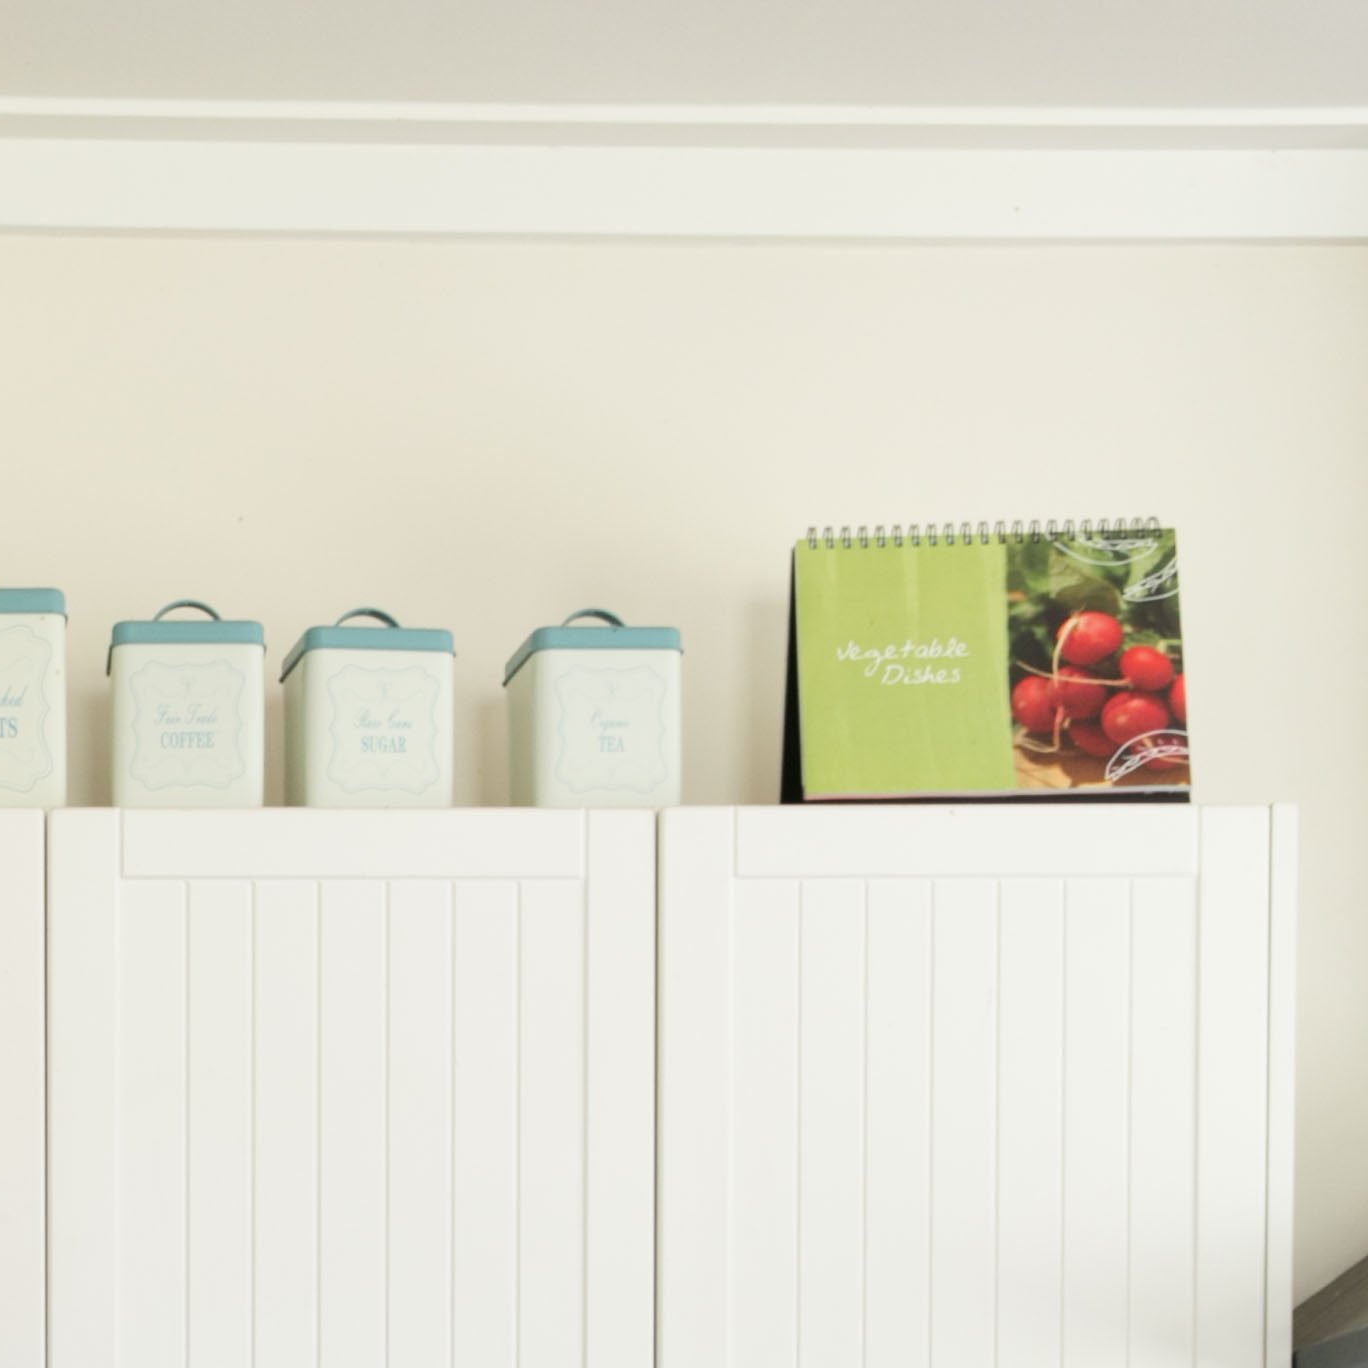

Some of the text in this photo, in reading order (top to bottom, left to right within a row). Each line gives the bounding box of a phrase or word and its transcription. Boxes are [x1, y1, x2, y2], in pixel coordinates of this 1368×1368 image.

[880, 662, 962, 686] Dishes
[160, 730, 216, 750] COFFEE
[359, 734, 408, 753] SUGAR
[598, 734, 626, 753] TEA
